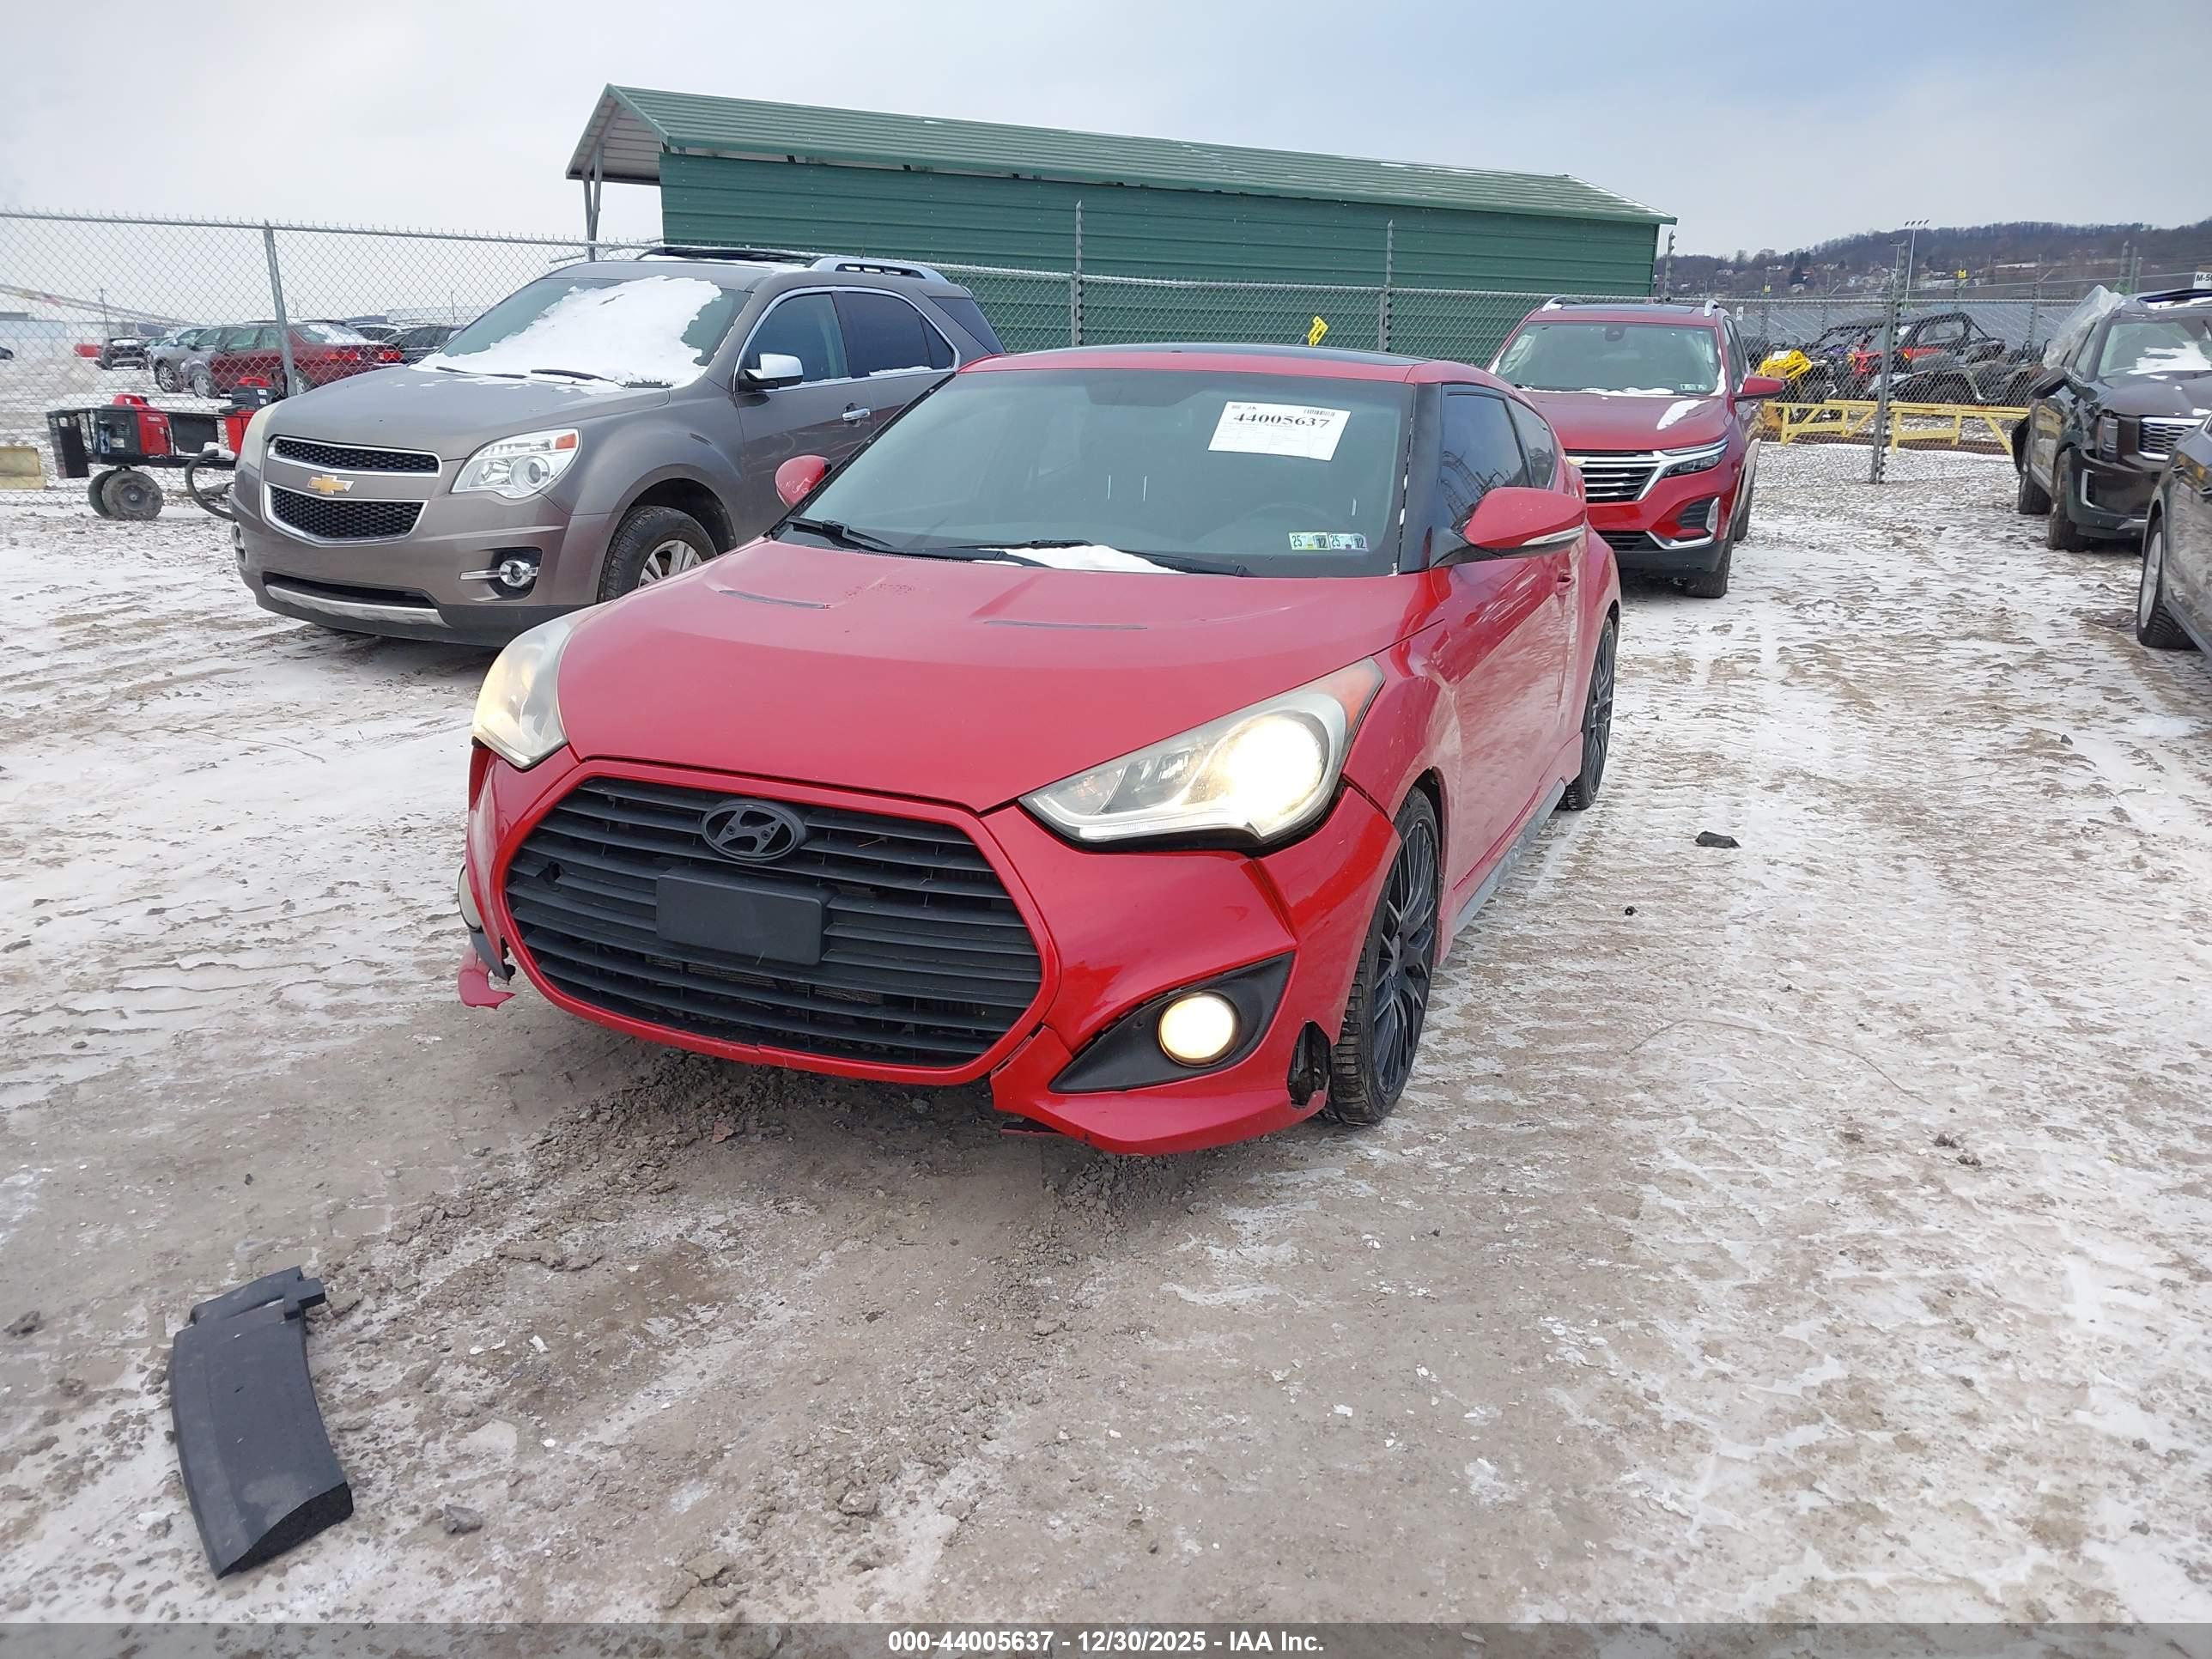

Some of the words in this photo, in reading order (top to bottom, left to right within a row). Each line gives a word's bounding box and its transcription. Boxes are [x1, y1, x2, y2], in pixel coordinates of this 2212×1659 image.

[2195, 273, 2212, 283] M-5
[1233, 412, 1331, 428] 44005637
[1291, 535, 1303, 547] 25
[1330, 535, 1340, 547] 25
